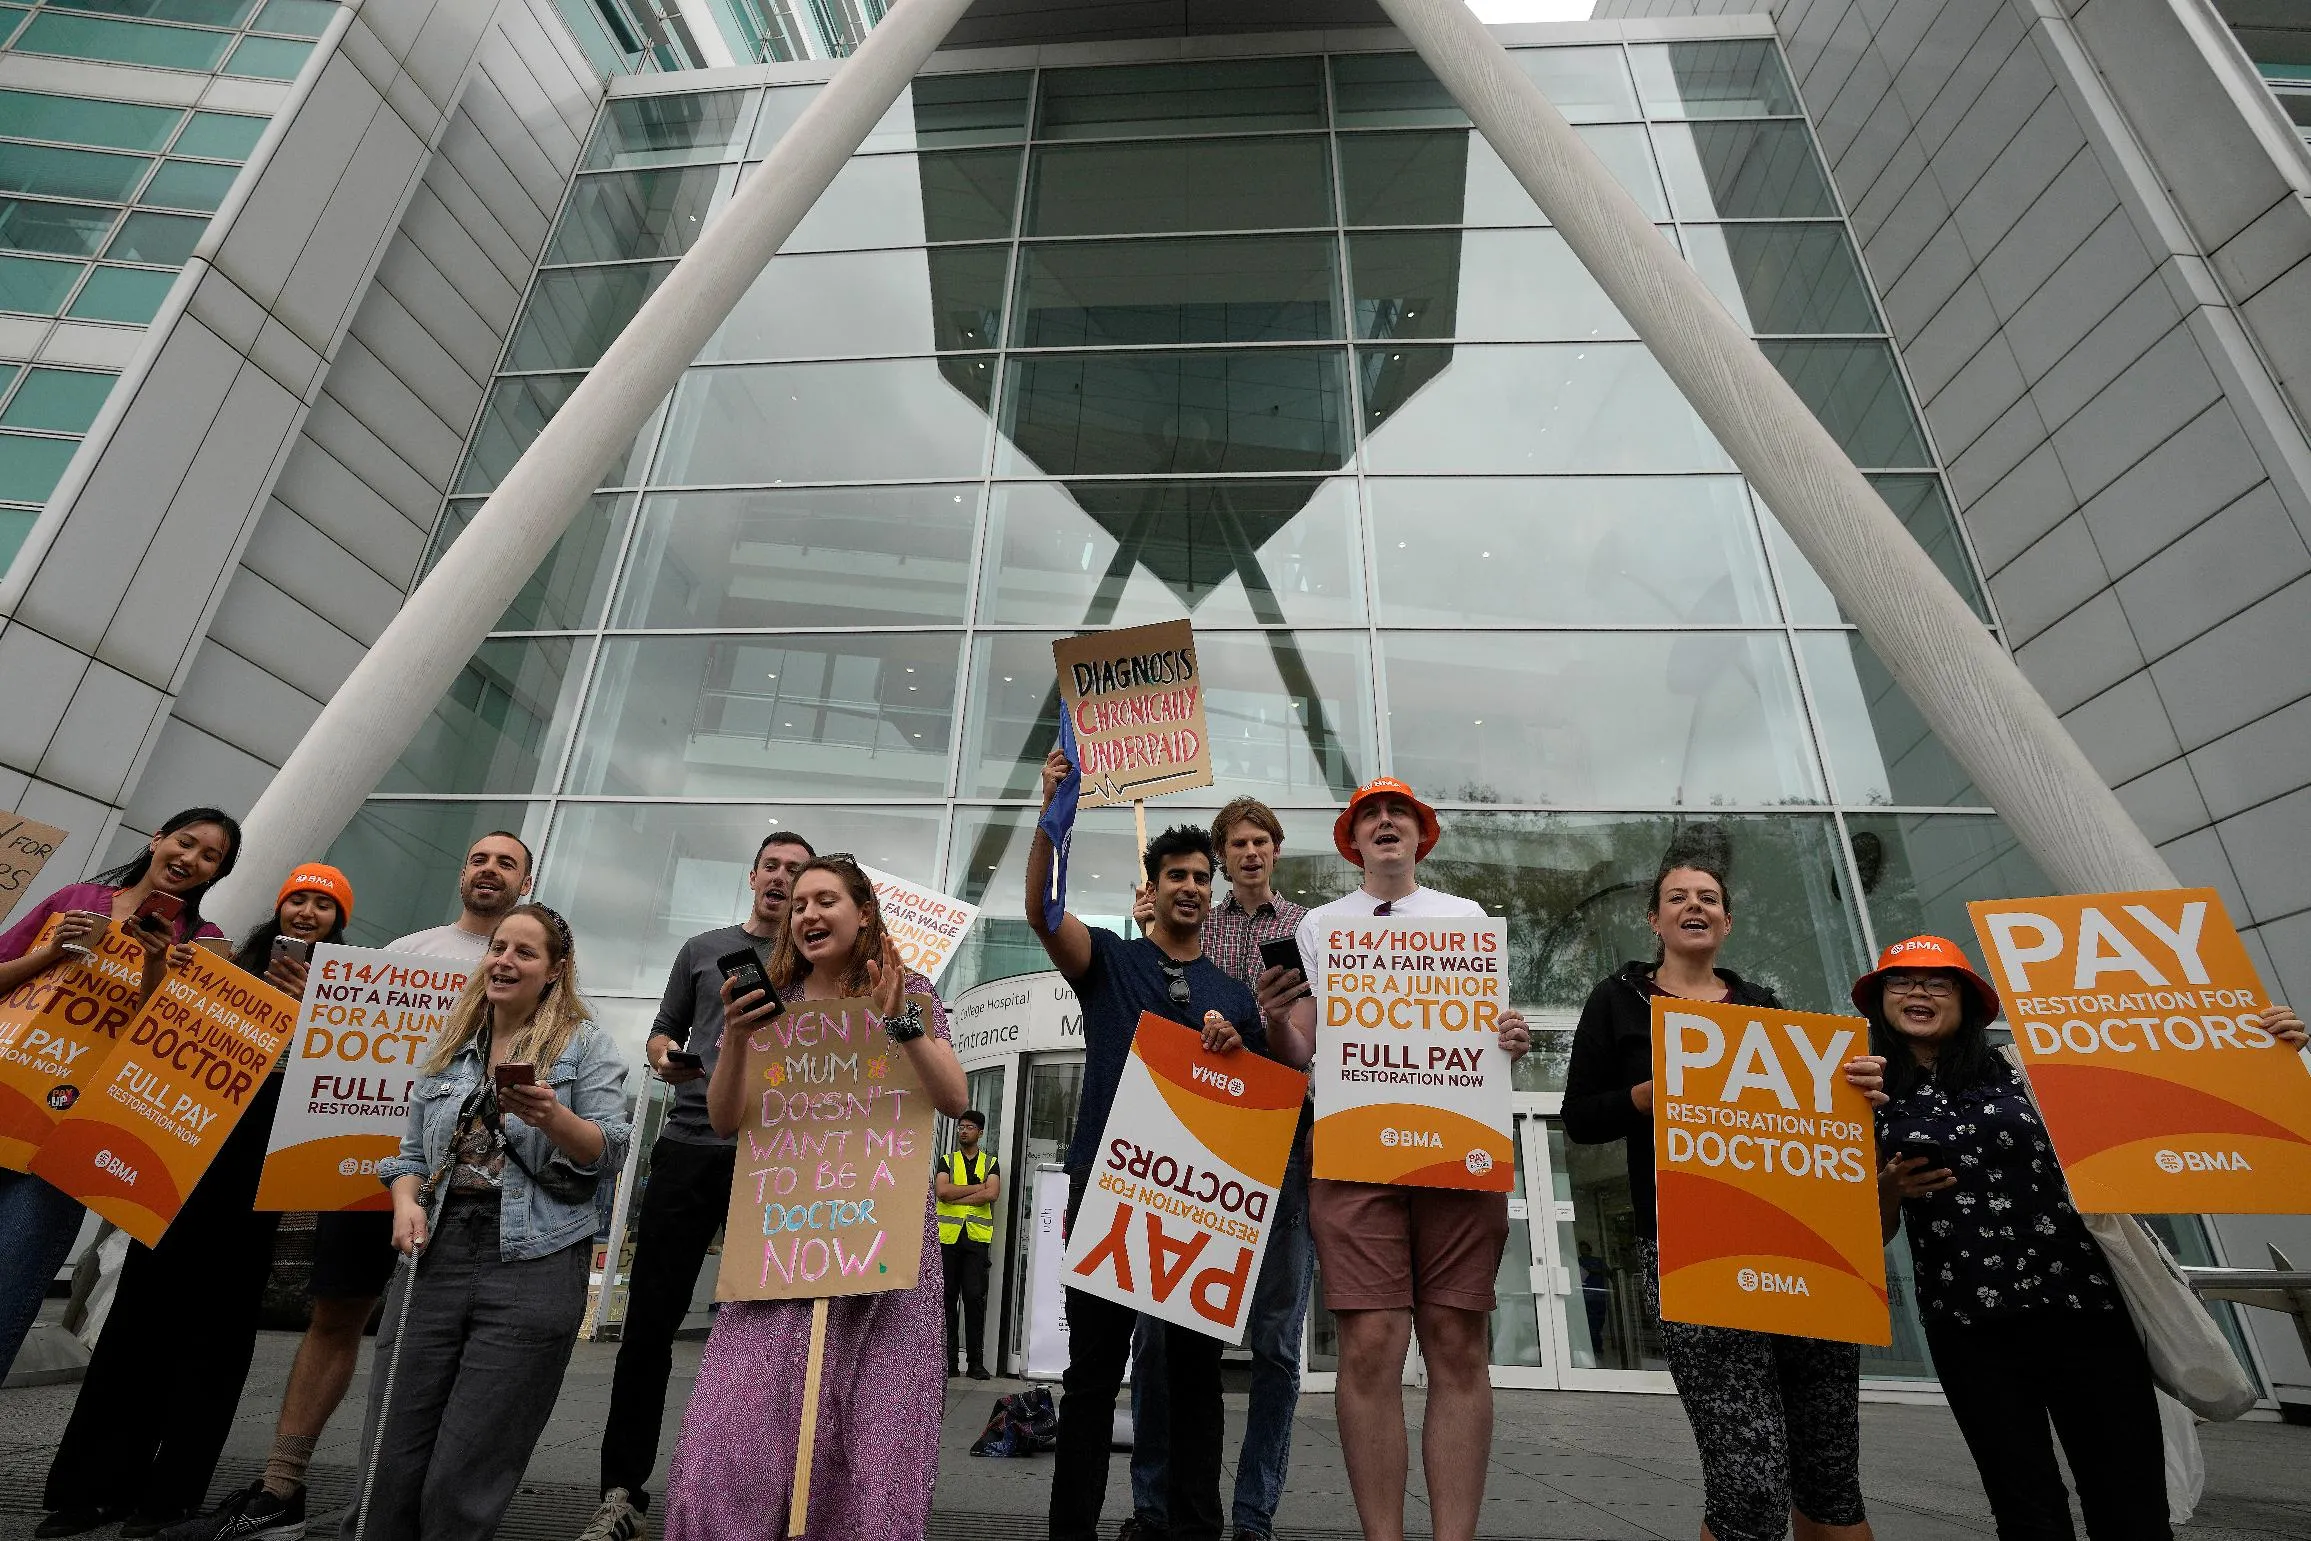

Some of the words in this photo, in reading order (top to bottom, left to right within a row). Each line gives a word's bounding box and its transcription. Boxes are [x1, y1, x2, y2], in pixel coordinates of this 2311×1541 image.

[1071, 648, 1193, 697] DIAGNOSIS
[1077, 728, 1200, 776] UNDERPAID
[8, 836, 52, 859] FOR
[307, 875, 334, 890] BMA
[883, 902, 917, 922] FAIR
[918, 914, 960, 938] WAGE
[947, 909, 968, 926] IS
[1328, 929, 1466, 952] £14/HOUR
[1473, 932, 1497, 953] IS
[1906, 941, 1942, 953] BMA
[1984, 901, 2212, 994] PAY
[100, 958, 142, 987] WAG
[322, 959, 468, 993] £14/HOUR
[1328, 953, 1368, 970] NOT
[1372, 954, 1387, 971] A
[1391, 955, 1435, 972] FAIR
[1440, 956, 1498, 973] WAGE
[178, 959, 272, 1024] £14/HOUR
[270, 1011, 293, 1034] IS
[315, 984, 364, 1003] NOT
[365, 989, 381, 1005] A
[386, 990, 433, 1010] FAIR
[987, 989, 1031, 1011] Hospital
[1327, 973, 1376, 994] FOR
[1382, 975, 1400, 995] A
[1405, 975, 1498, 999] JUNIOR
[165, 979, 198, 1004] NOT
[193, 997, 208, 1012] A
[206, 1002, 240, 1030] FAIR
[238, 1020, 280, 1054] WAGE
[310, 1004, 367, 1027] FOR
[371, 1009, 390, 1030] A
[395, 1011, 445, 1034] JUN
[1326, 996, 1499, 1033] DOCTOR
[2016, 990, 2197, 1017] RESTORATION
[2199, 989, 2258, 1009] FOR
[21, 1028, 90, 1065] PAY
[151, 995, 190, 1028] FOR
[185, 1018, 203, 1038] A
[198, 1025, 267, 1075] JUNIOR
[302, 1027, 428, 1066] DOCT
[750, 1010, 850, 1051] EVEN
[958, 1023, 1019, 1054] Entrance
[2024, 1013, 2276, 1056] DOCTORS
[32, 1059, 73, 1079] NOW
[130, 1014, 253, 1106] DOCTOR
[785, 1052, 858, 1085] MUM
[1342, 1042, 1419, 1069] FULL
[1428, 1046, 1485, 1072] PAY
[1664, 1011, 1855, 1114] PAY
[311, 1075, 395, 1102] FULL
[1192, 1062, 1229, 1091] BMA
[1341, 1069, 1444, 1086] RESTORATION
[1449, 1074, 1484, 1088] NOW
[116, 1060, 171, 1110] FULL
[170, 1093, 218, 1133] PAY
[308, 1101, 410, 1117] RESTORATIO
[106, 1084, 176, 1132] RESTORATION
[173, 1125, 202, 1147] NOW
[1667, 1102, 1815, 1137] RESTORATION
[1820, 1119, 1863, 1141] FOR
[748, 1128, 853, 1163] WANT
[864, 1127, 919, 1160] ME
[1401, 1130, 1443, 1149] BMA
[1667, 1127, 1866, 1183] DOCTORS
[106, 1156, 139, 1187] BMA
[2184, 1151, 2252, 1172] BMA
[749, 1166, 798, 1205] TO
[815, 1160, 857, 1192] BE
[869, 1159, 896, 1193] A
[1098, 1171, 1137, 1200] FOR
[1106, 1138, 1269, 1224] DOCTORS
[763, 1198, 878, 1236] DOCTOR
[1138, 1187, 1260, 1245] RESTORATION
[1072, 1201, 1255, 1329] PAY
[1761, 1272, 1809, 1296] BMA
